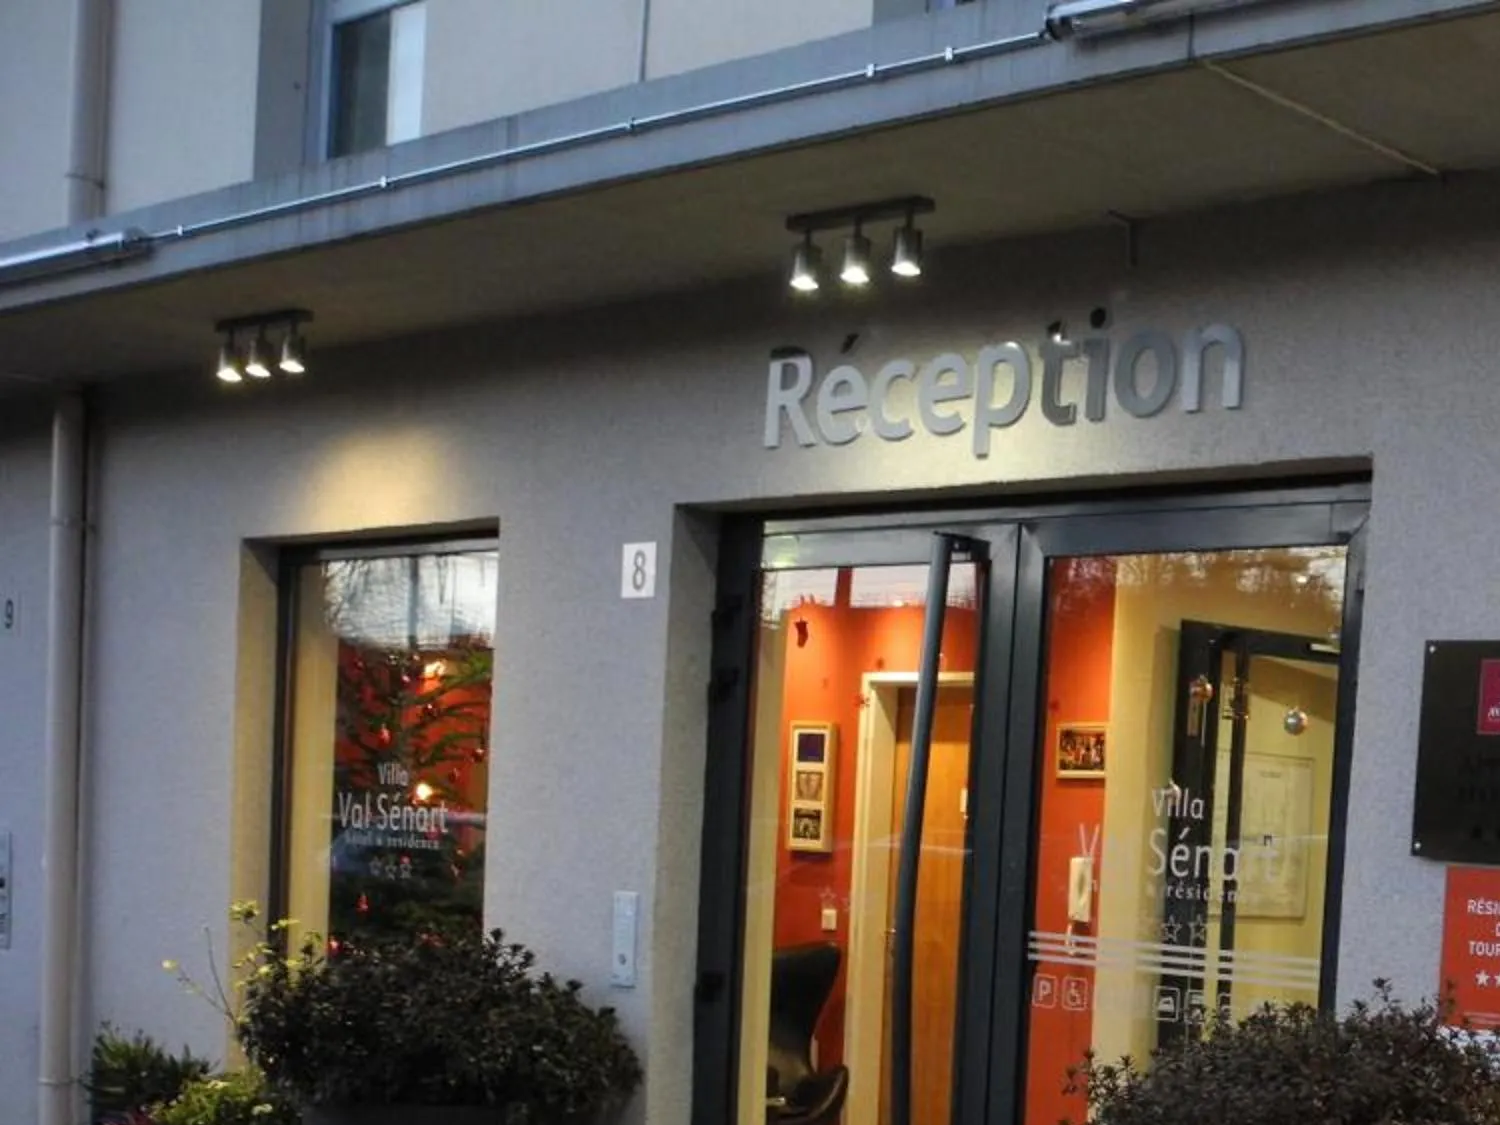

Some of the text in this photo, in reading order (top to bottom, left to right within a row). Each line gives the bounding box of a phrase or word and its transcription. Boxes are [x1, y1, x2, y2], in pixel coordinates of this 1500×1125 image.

[763, 306, 1245, 459] Réception
[632, 549, 647, 591] 8
[377, 762, 410, 787] Villa
[338, 791, 449, 834] Val Sénart
[1151, 786, 1205, 819] Villa
